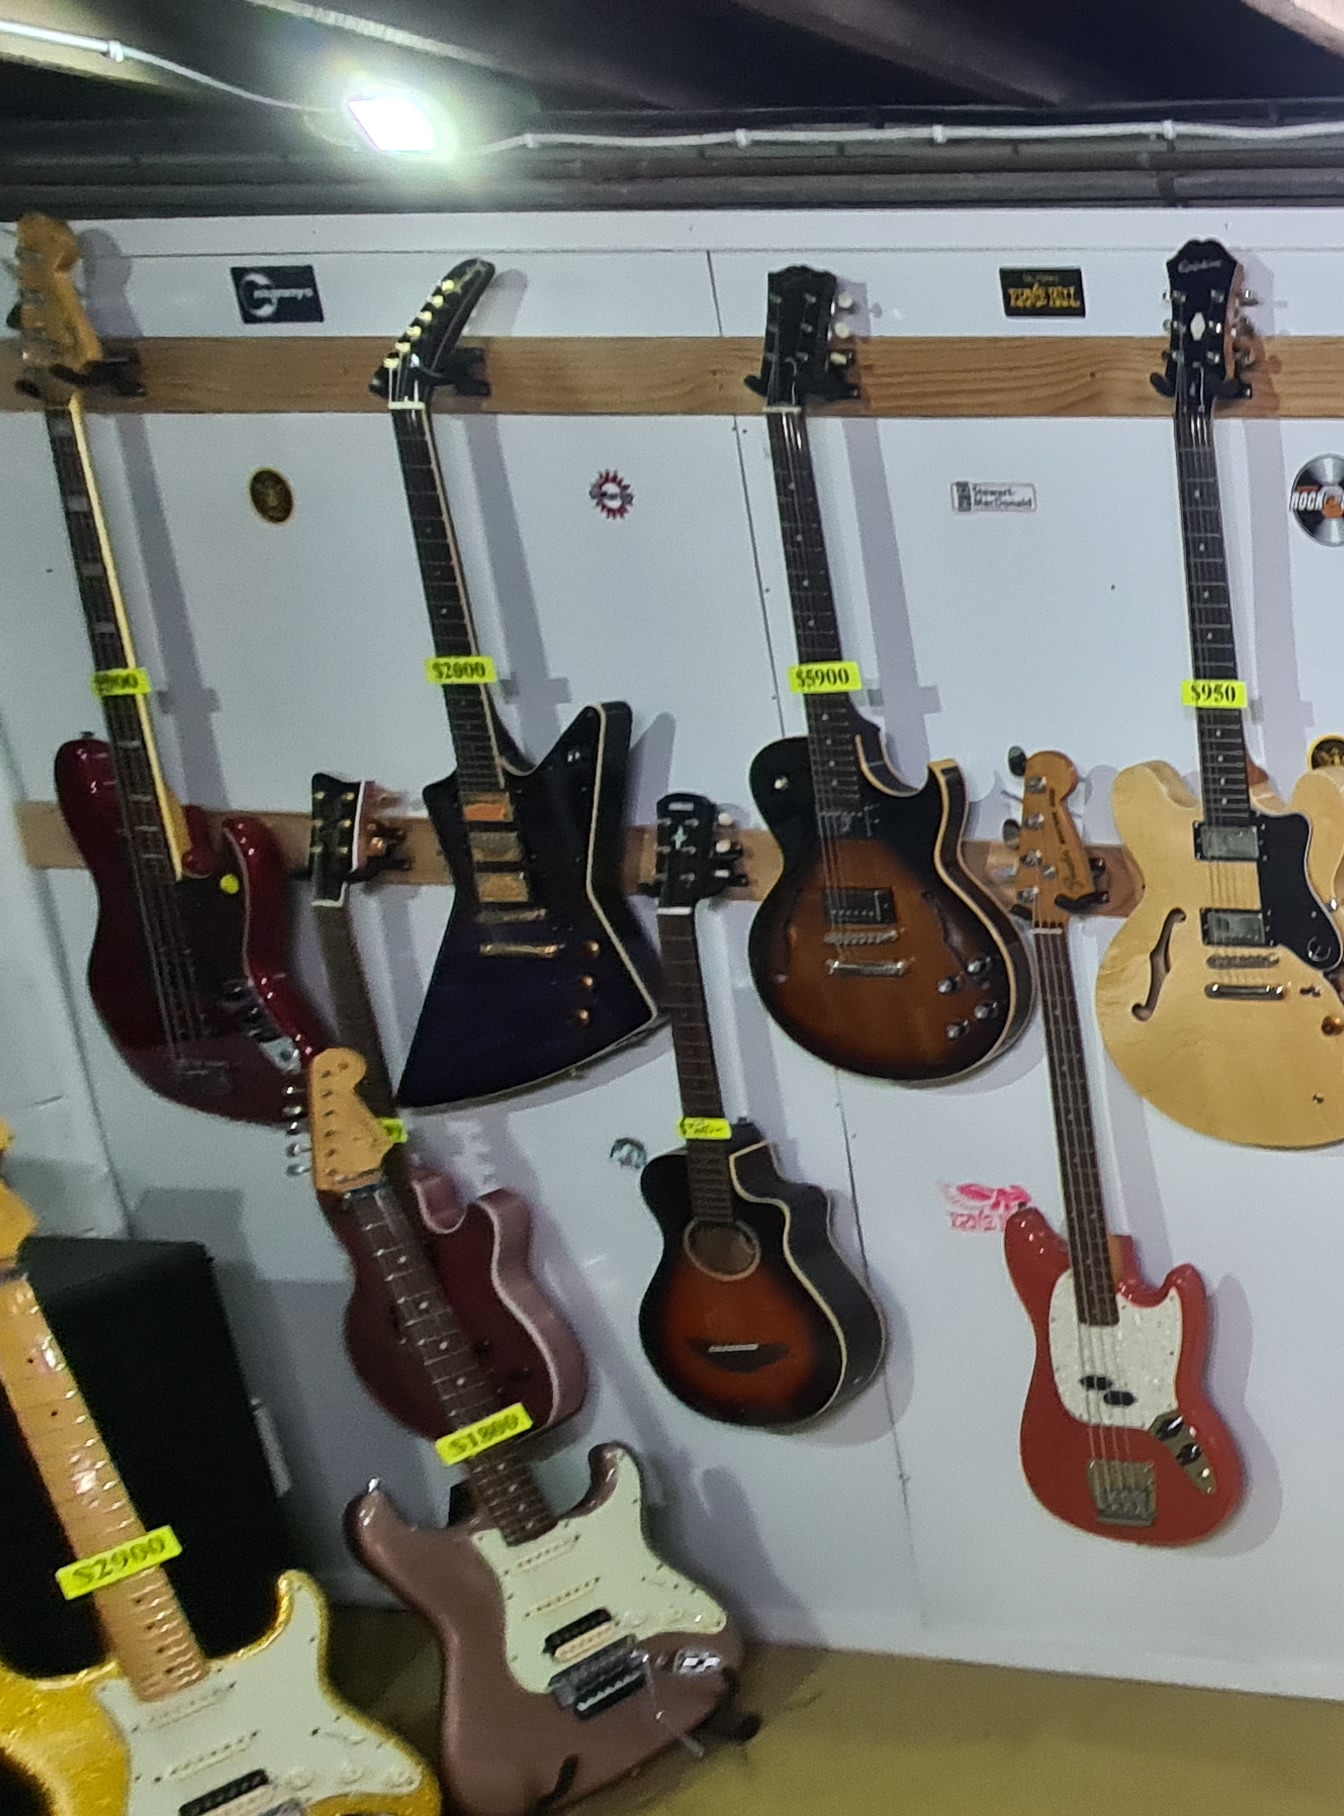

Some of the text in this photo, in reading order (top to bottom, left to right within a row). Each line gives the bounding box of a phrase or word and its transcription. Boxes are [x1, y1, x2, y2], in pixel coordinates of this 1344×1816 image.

[1290, 491, 1328, 512] ROCK
[431, 661, 486, 680] $2000
[796, 667, 850, 689] $5900
[1190, 683, 1237, 703] $950
[72, 1535, 166, 1585] $2900
